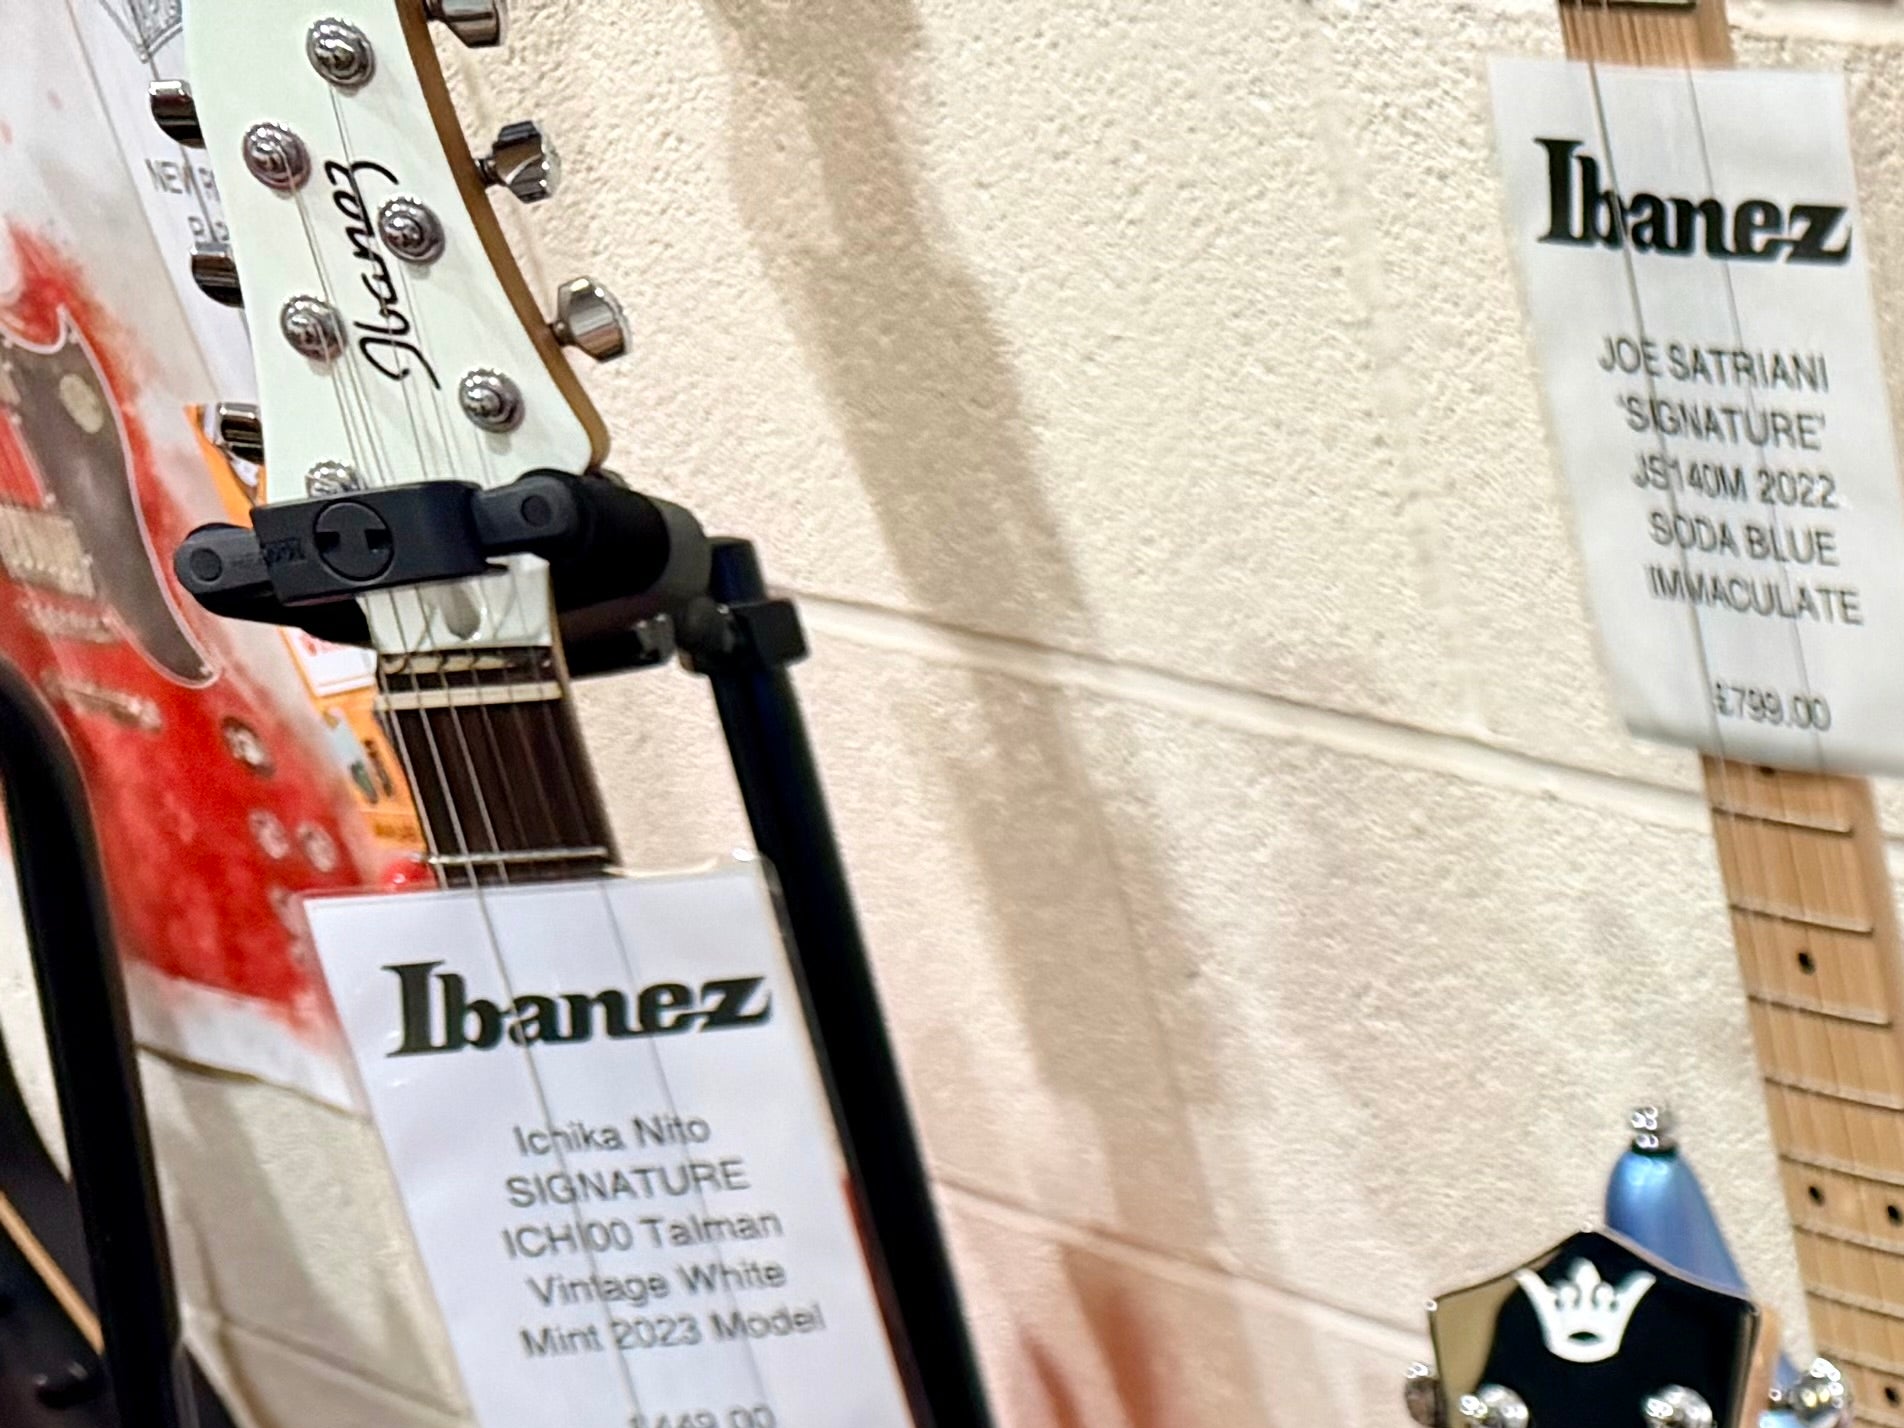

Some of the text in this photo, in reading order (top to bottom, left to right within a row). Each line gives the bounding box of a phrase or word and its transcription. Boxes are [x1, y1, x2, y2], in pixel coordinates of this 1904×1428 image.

[1533, 137, 1852, 266] Ibanez
[324, 161, 441, 390] Ibanez
[1598, 335, 1829, 393] JOE SATRIANI
[1631, 454, 1840, 510] JS140M 2022
[1649, 511, 1841, 567] SODA BLUE
[1645, 563, 1864, 626] IMMACULATE
[1715, 681, 1832, 732] £799.00
[381, 961, 772, 1058] Ibanez
[513, 1114, 711, 1157] Ichika Nito
[505, 1158, 751, 1209] SIGNATURE
[639, 1212, 783, 1248] Talman
[525, 1258, 787, 1307] Vintage White
[519, 1302, 827, 1358] Mint 2023 Model
